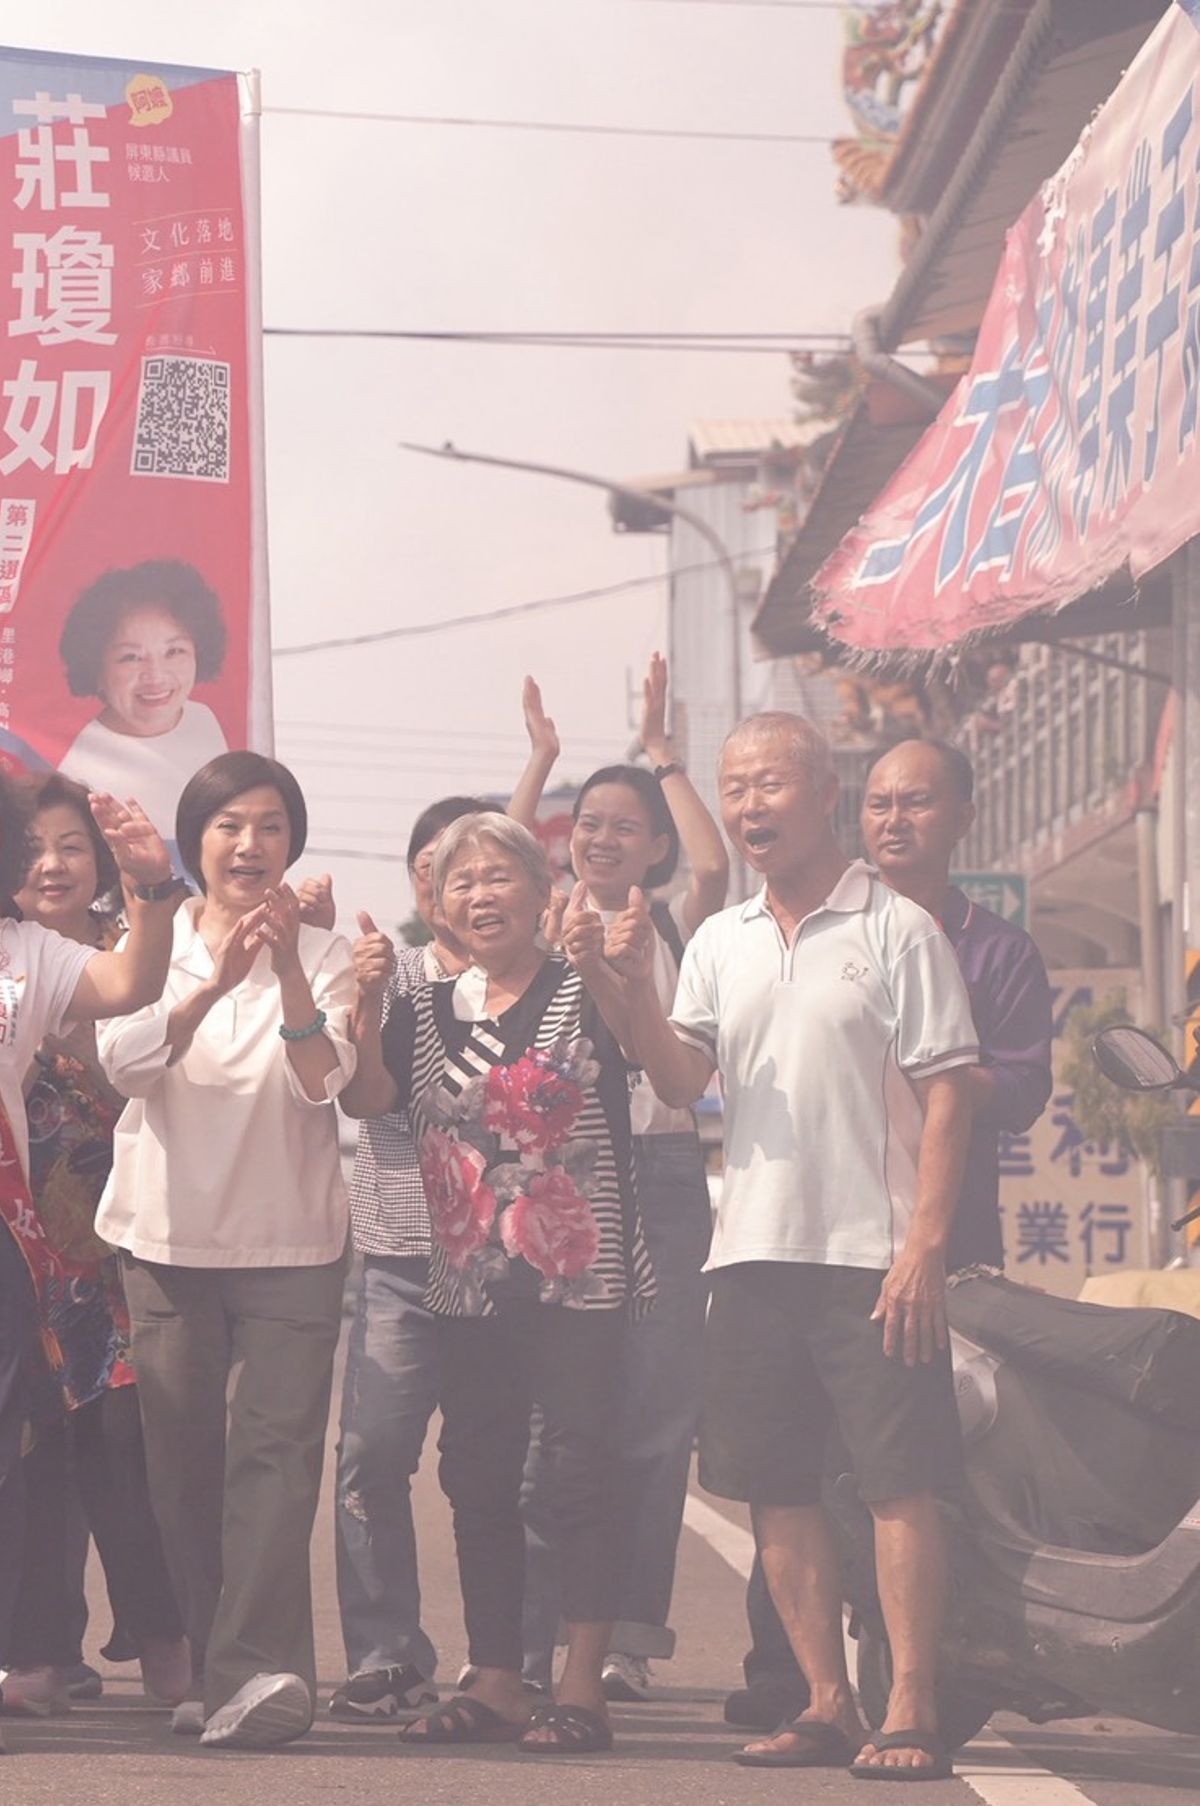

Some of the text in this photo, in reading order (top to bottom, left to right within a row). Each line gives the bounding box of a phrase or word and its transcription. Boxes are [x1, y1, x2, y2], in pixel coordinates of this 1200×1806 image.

[125, 142, 192, 165] 屏東縣議員
[127, 161, 171, 183] 候選人
[140, 216, 235, 255] 文化落地
[141, 257, 237, 296] 家鄉前進
[999, 1200, 1133, 1265] 業行
